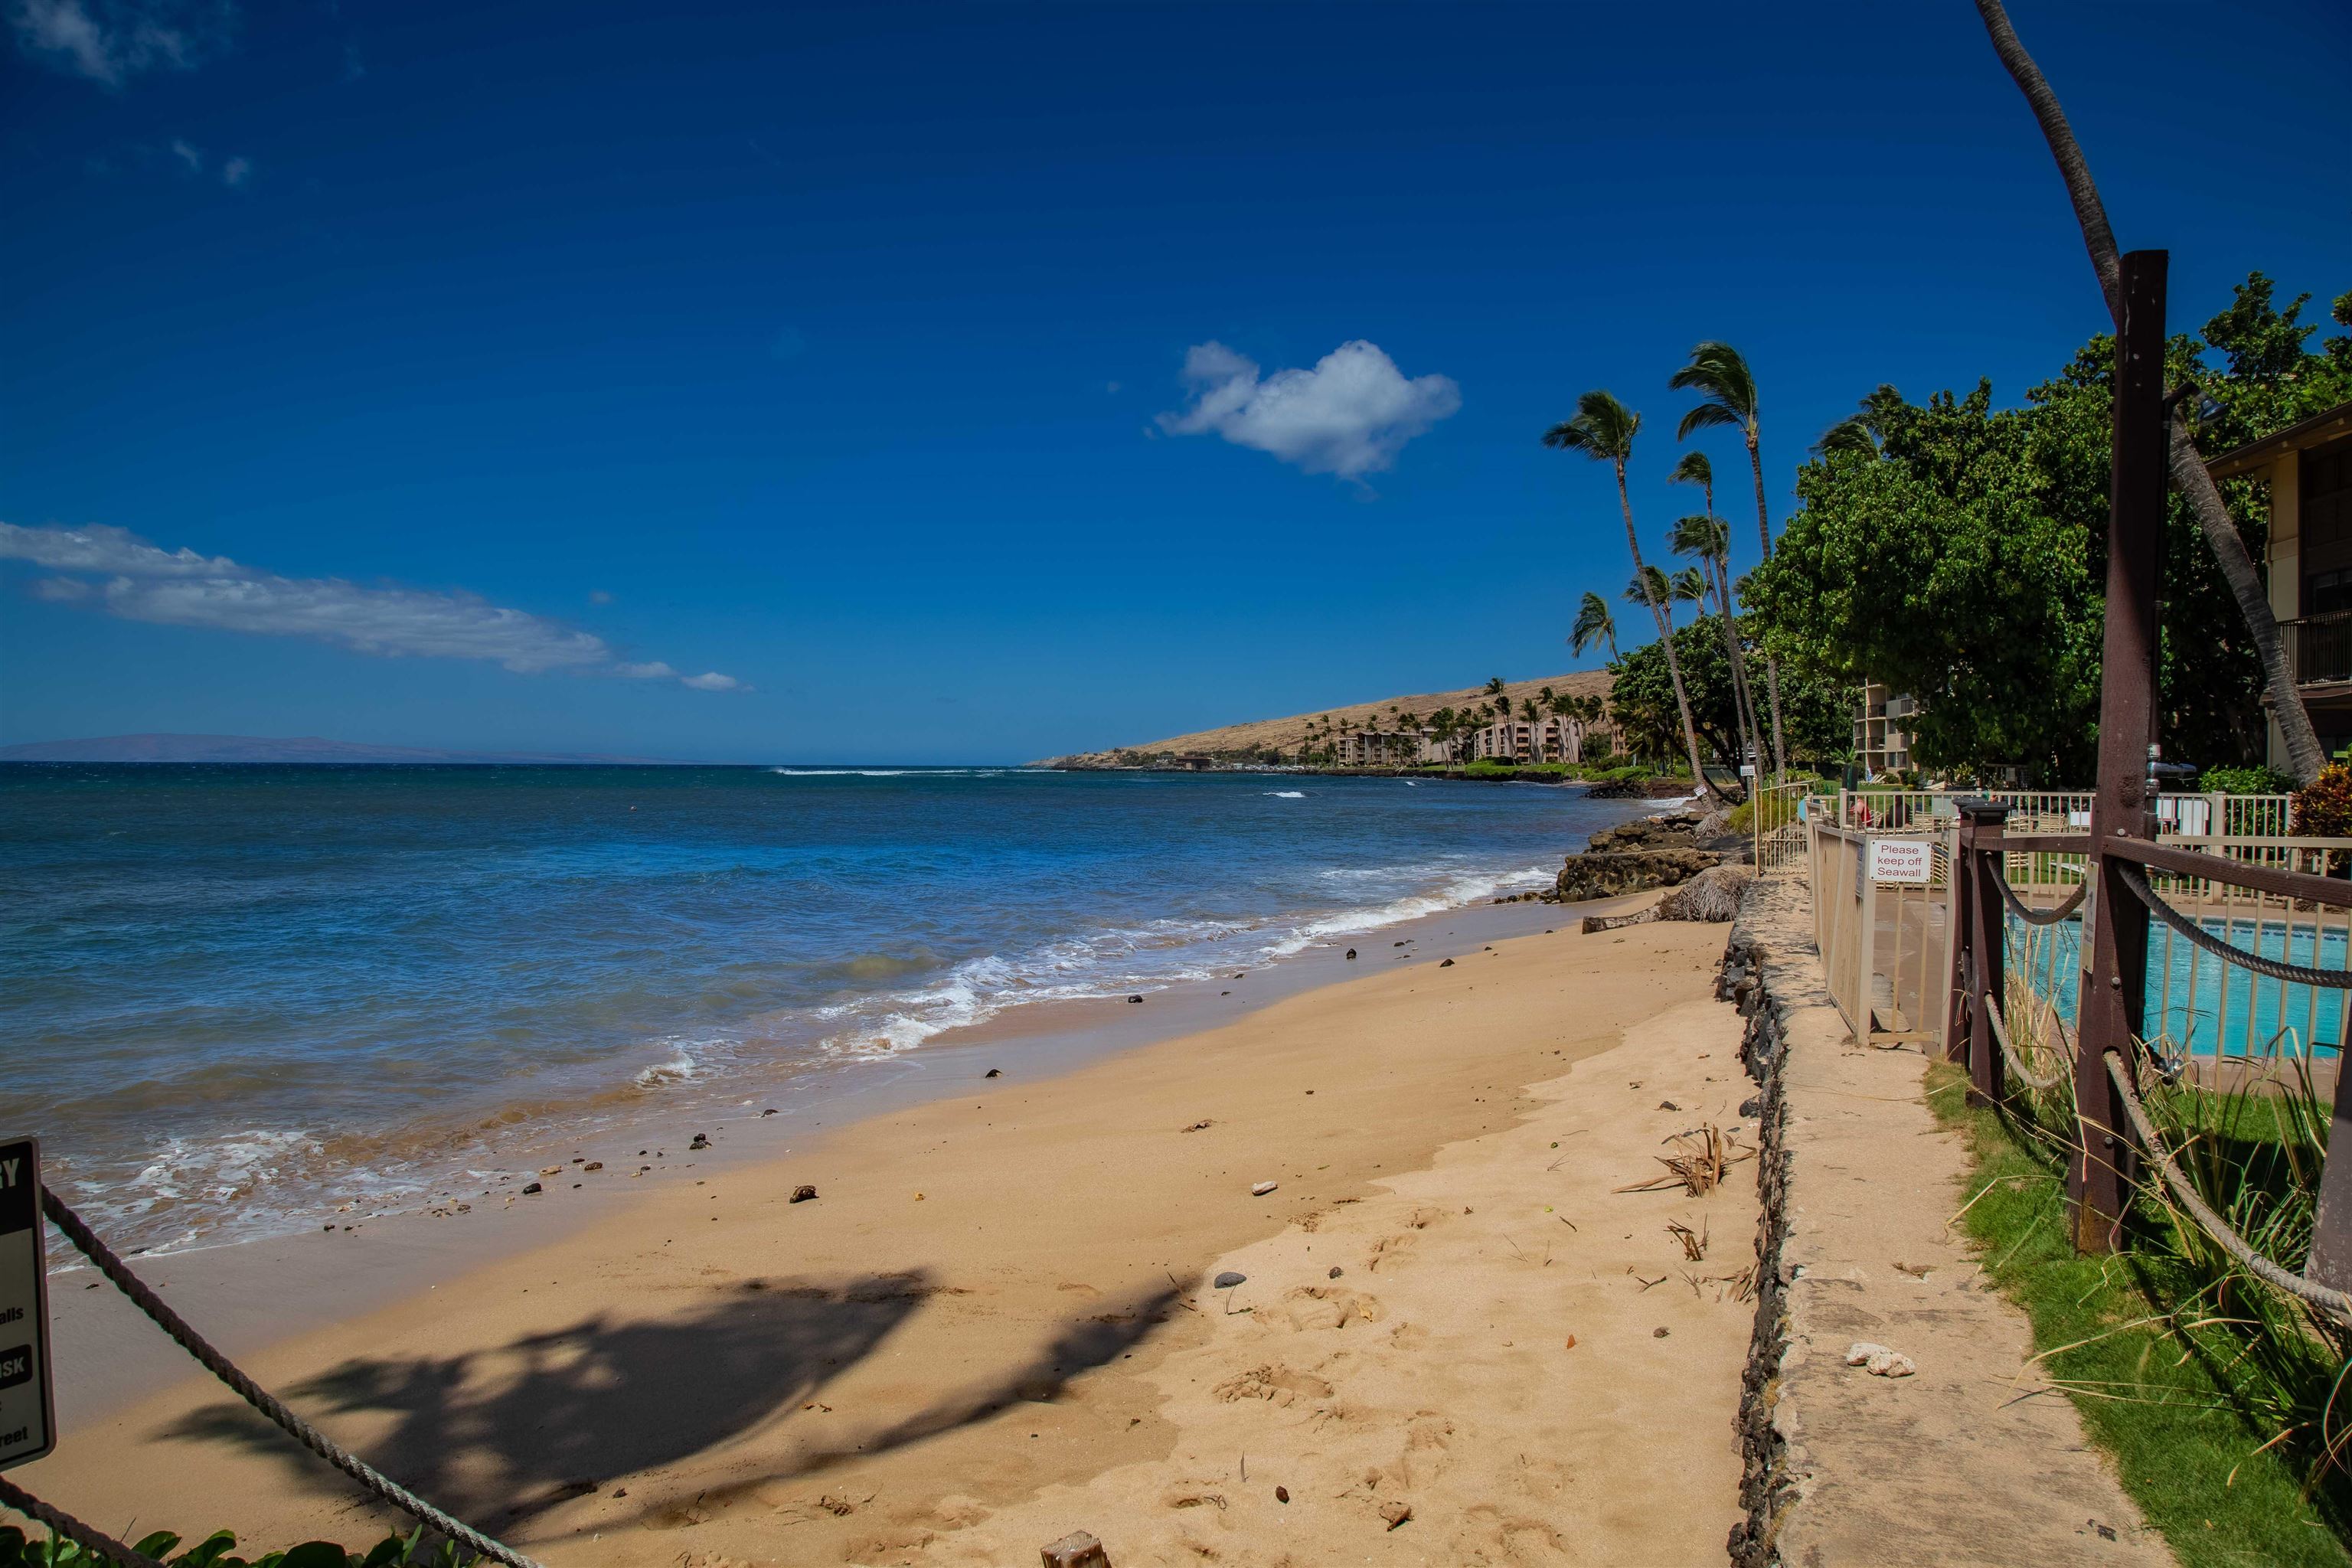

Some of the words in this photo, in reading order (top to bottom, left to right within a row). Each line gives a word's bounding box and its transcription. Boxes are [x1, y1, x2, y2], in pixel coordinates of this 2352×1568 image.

[1881, 844, 1919, 854] Please
[1877, 856, 1904, 866] keep
[1908, 857, 1922, 865] off
[1877, 867, 1921, 877] Seawall
[0, 1158, 20, 1188] Y
